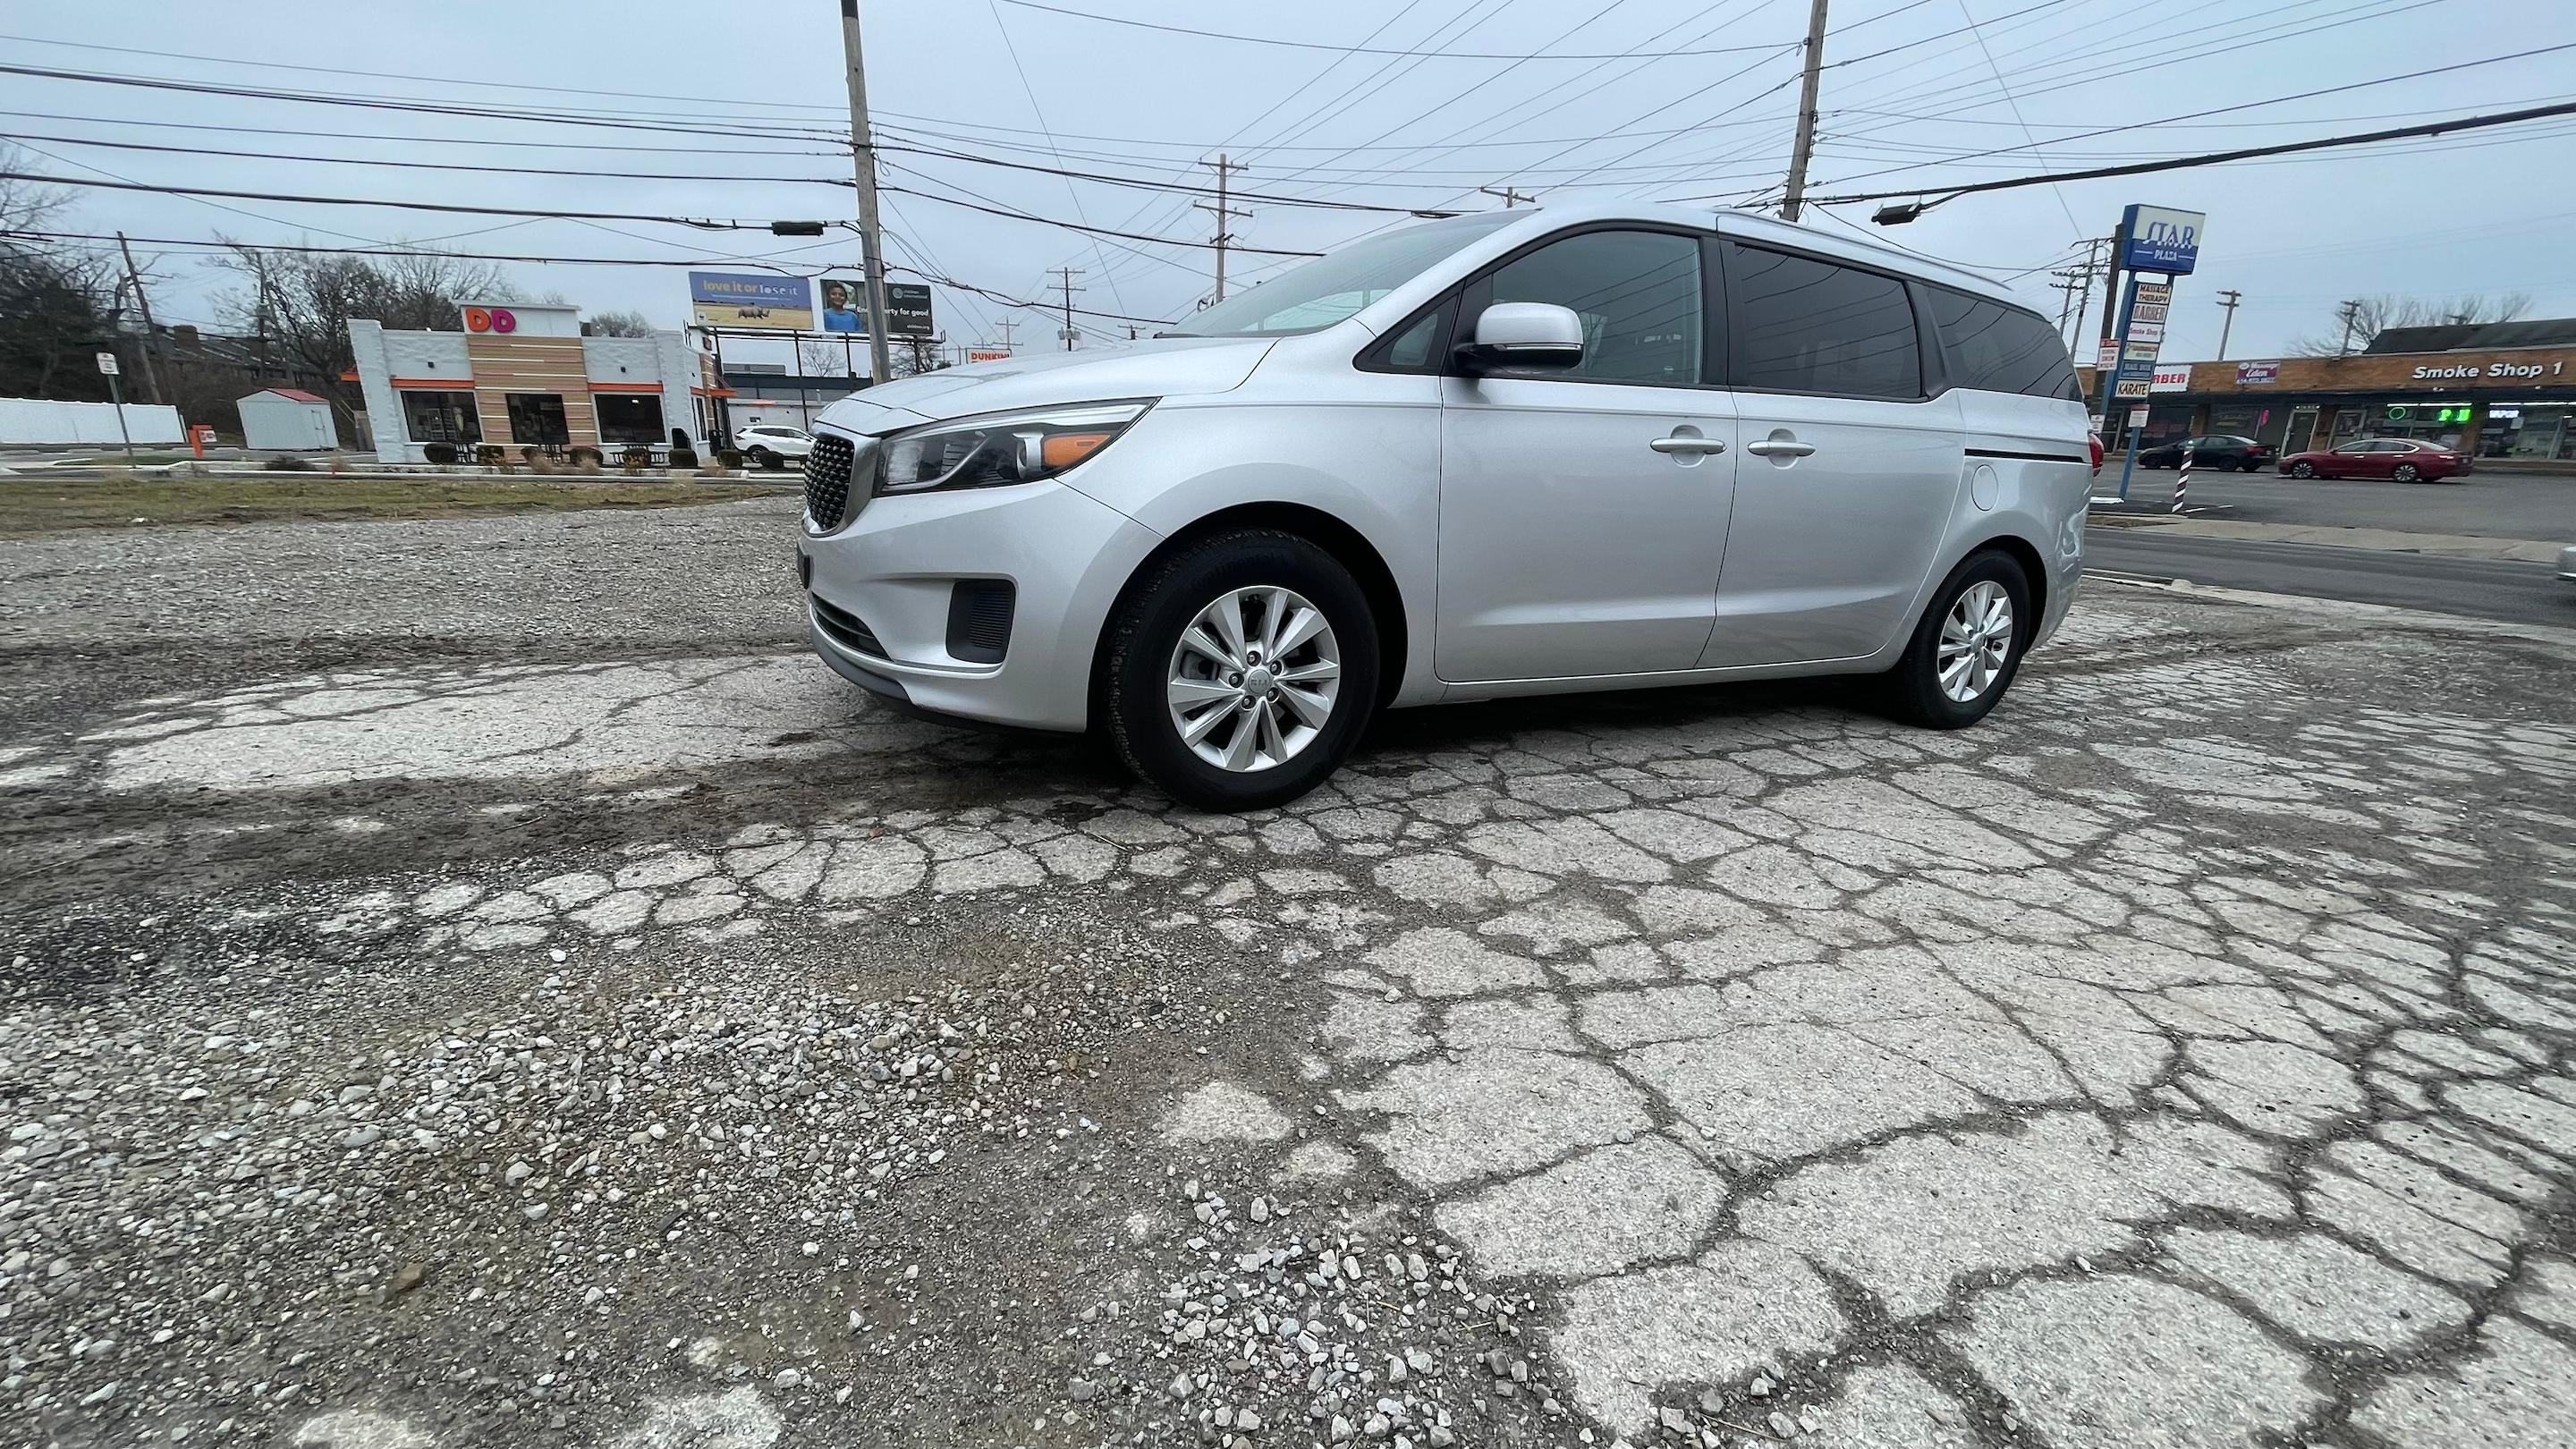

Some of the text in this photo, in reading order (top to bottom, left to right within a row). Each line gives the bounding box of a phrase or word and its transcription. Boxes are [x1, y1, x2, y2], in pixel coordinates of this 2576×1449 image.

[2142, 221, 2194, 249] STAR
[2154, 250, 2177, 261] PLAZA
[703, 280, 798, 295] love it or lose it
[900, 307, 910, 315] for
[911, 309, 929, 317] good
[465, 307, 516, 333] DD
[2412, 360, 2563, 379] Smoke Shop 1
[2151, 373, 2186, 384] RBER
[2118, 383, 2148, 394] KARATE
